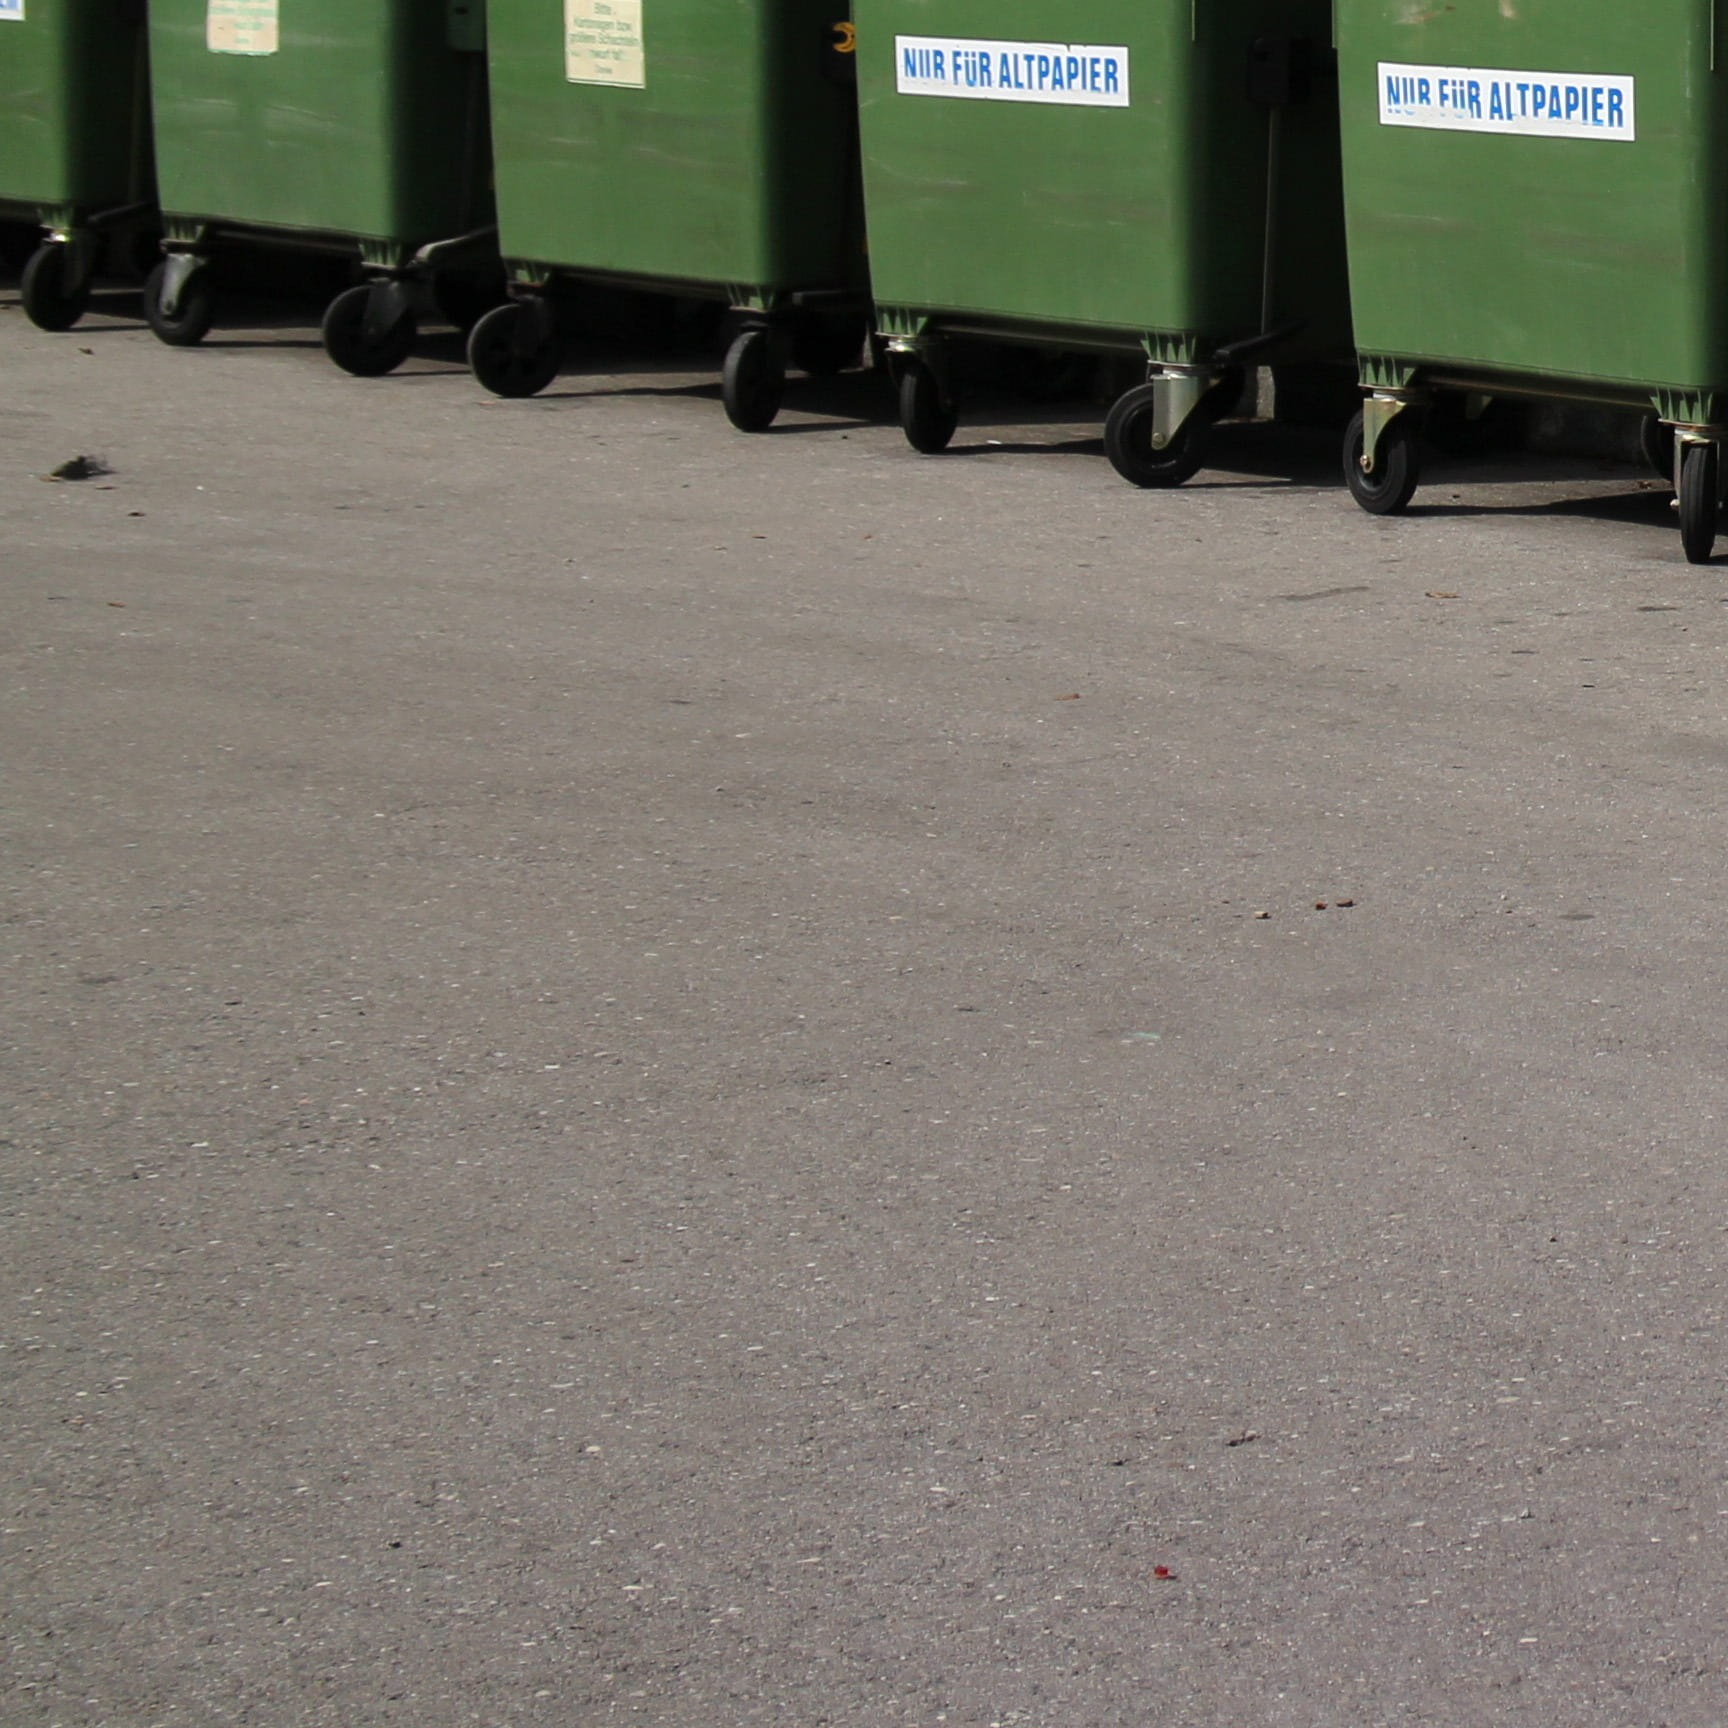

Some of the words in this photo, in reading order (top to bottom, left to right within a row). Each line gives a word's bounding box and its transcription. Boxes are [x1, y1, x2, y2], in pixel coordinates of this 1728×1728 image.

[952, 50, 992, 88] FÜR
[999, 53, 1119, 93] ALTPAPIER
[1489, 81, 1624, 128] ALTPAPIER
